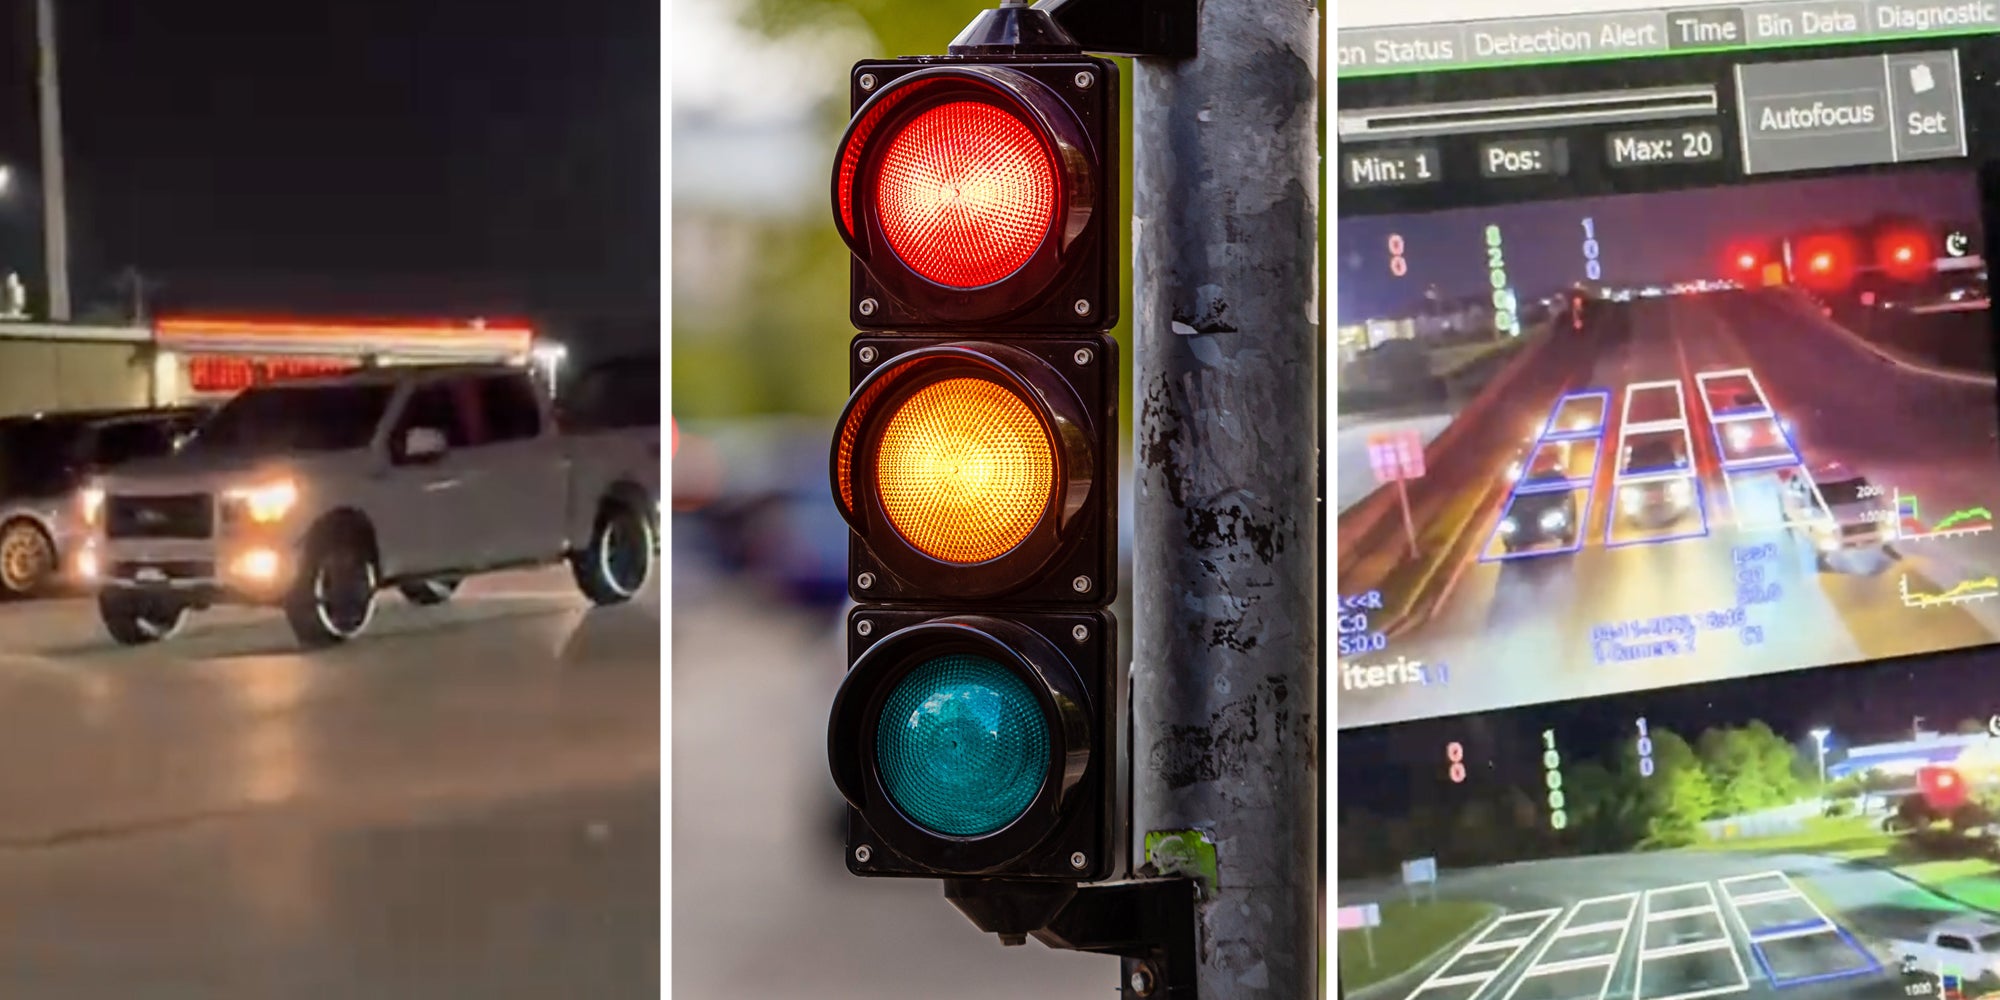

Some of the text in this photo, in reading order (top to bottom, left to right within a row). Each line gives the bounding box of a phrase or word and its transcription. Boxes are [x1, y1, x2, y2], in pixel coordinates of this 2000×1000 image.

[1676, 19, 1737, 43] Time
[1758, 11, 1857, 37] Bin Data
[1373, 39, 1453, 62] Status
[1475, 22, 1657, 55] Detection Alert
[1760, 102, 1875, 131] Autofocus
[1908, 111, 1947, 135] Set
[1489, 148, 1541, 172] Pos:
[1614, 132, 1713, 161] Max: 20
[1352, 154, 1431, 182] Min: 1
[1342, 656, 1422, 690] iteris
